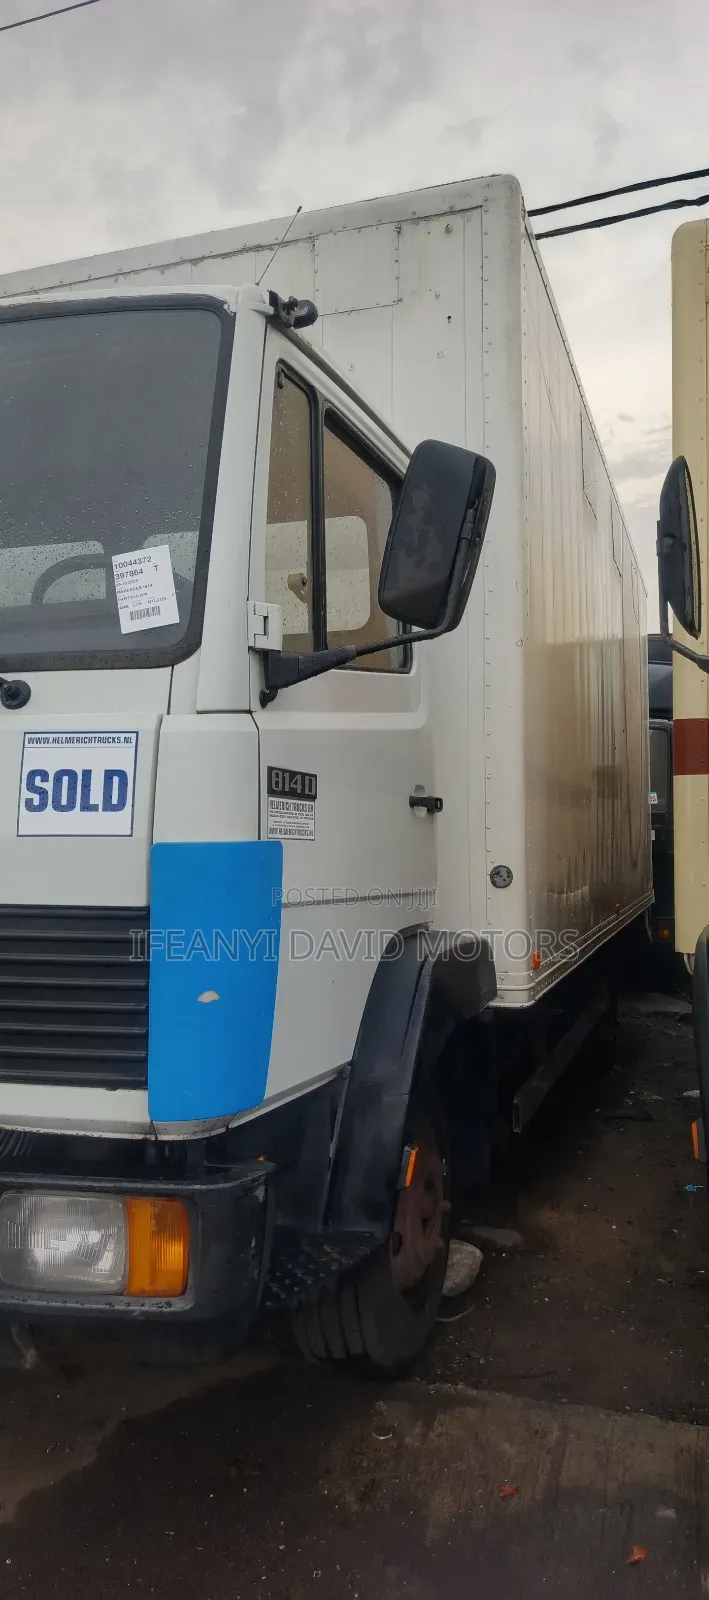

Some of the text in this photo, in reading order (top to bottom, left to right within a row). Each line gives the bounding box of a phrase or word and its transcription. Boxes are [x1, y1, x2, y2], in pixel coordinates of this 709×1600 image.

[114, 556, 152, 570] 10044372
[114, 564, 159, 580] 397864 T
[27, 736, 133, 745] WWW.HELMERICHTRUCKS.NL
[24, 768, 128, 813] SOLD
